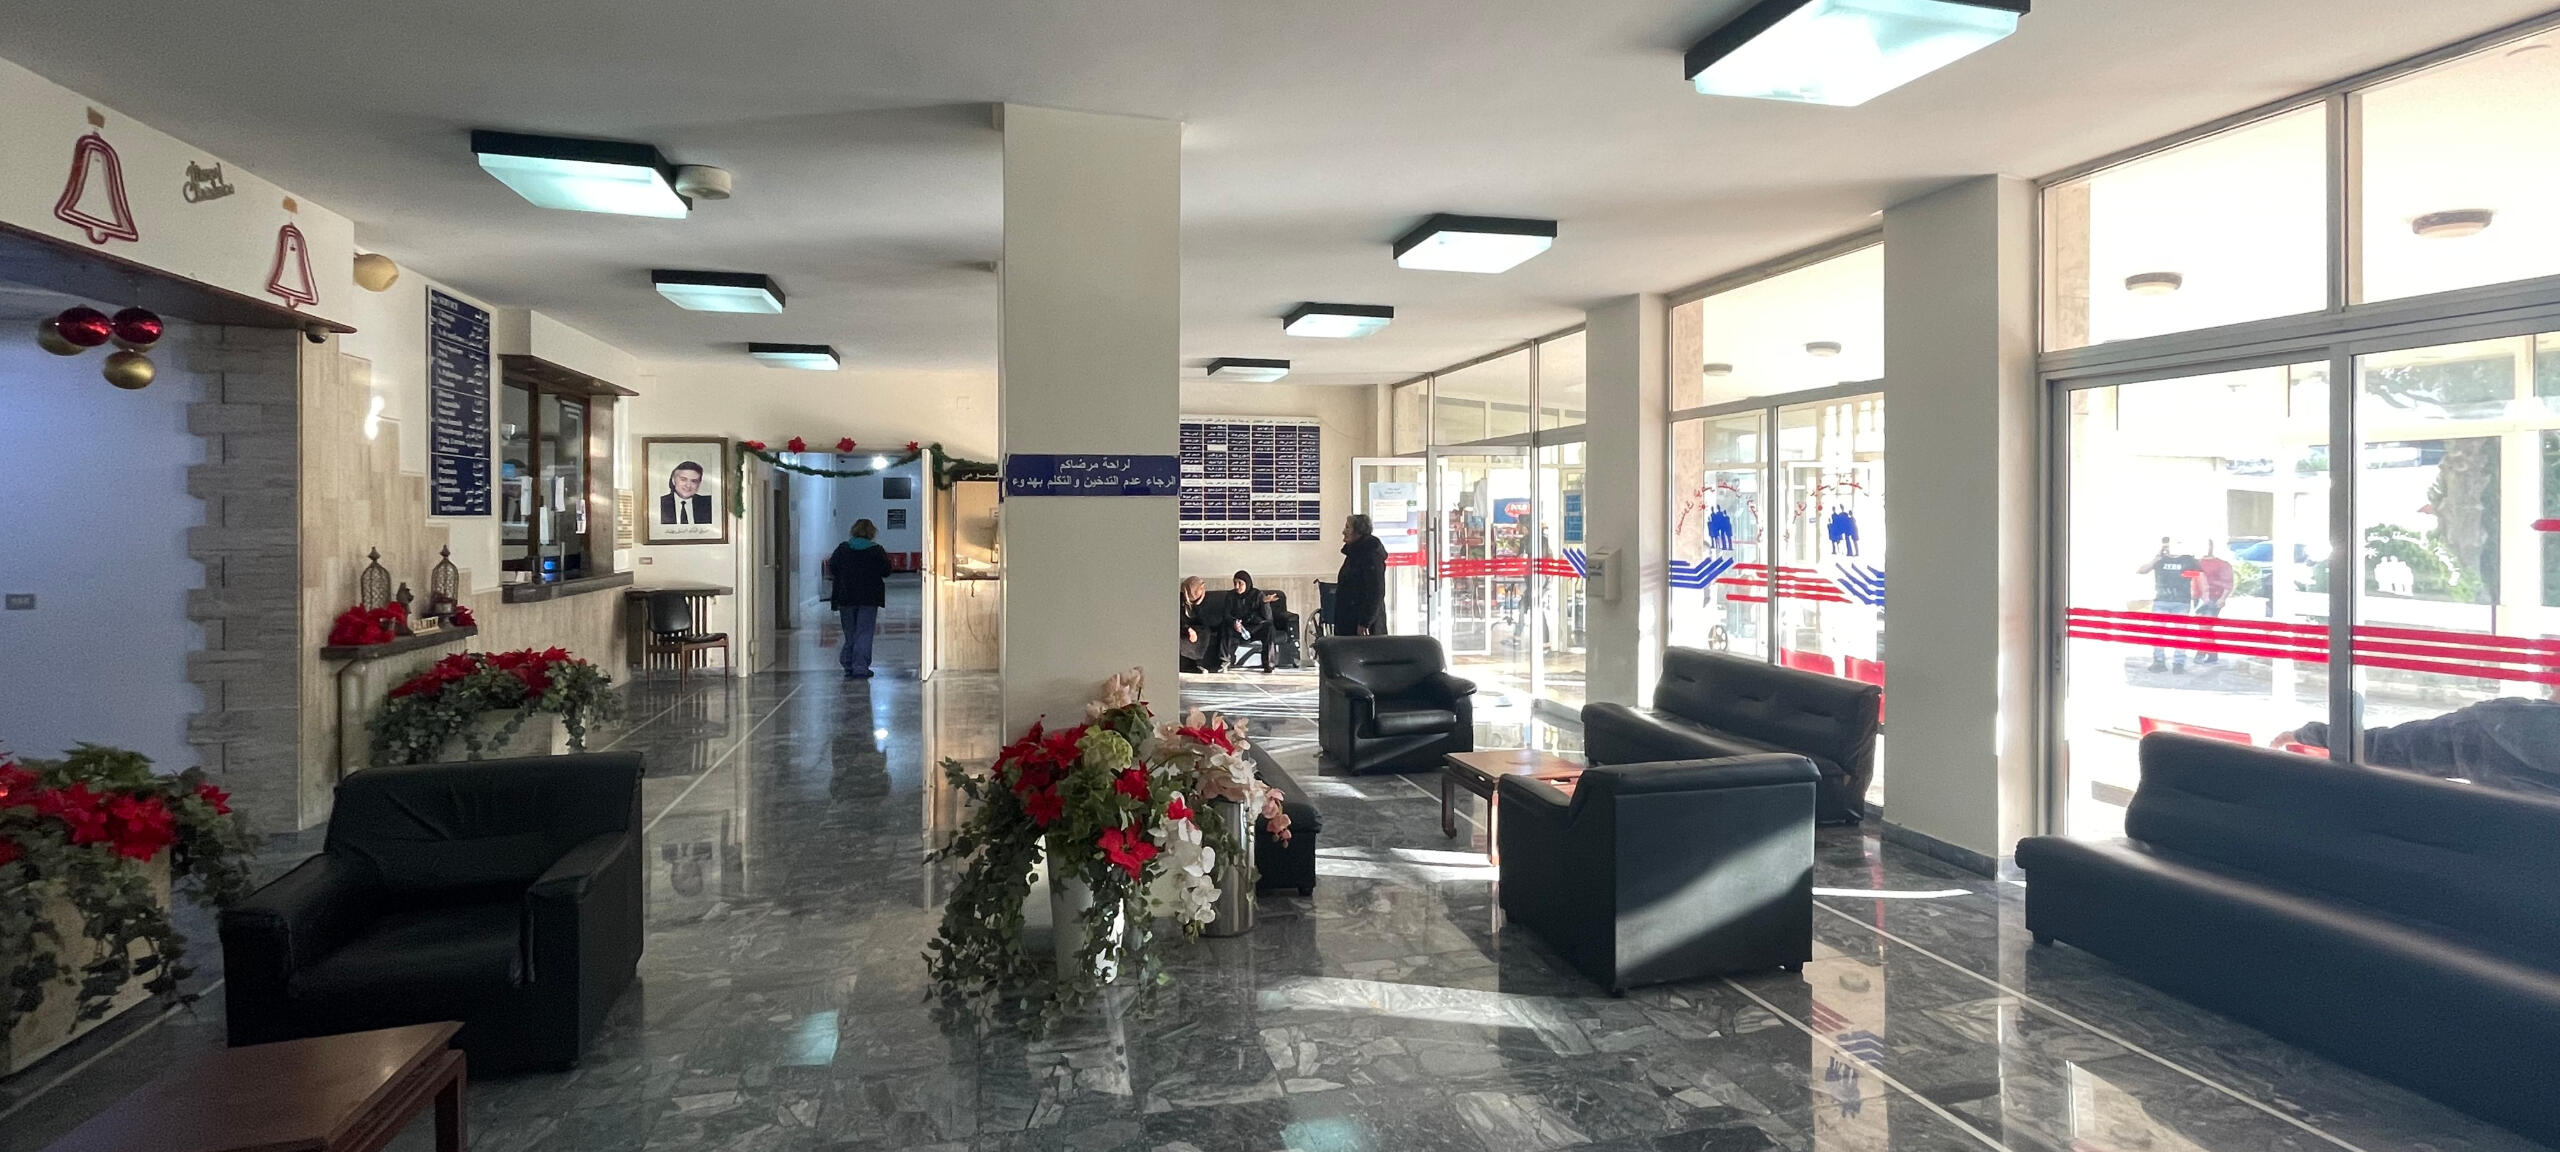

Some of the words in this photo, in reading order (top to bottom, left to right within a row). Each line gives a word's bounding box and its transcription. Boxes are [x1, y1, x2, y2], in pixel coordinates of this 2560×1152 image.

[1059, 458, 1098, 473] مرضاكم
[1103, 458, 1131, 471] لراحة
[1084, 475, 1119, 488] التدخين
[1123, 477, 1141, 488] عدم
[1146, 475, 1176, 487] الرجاء
